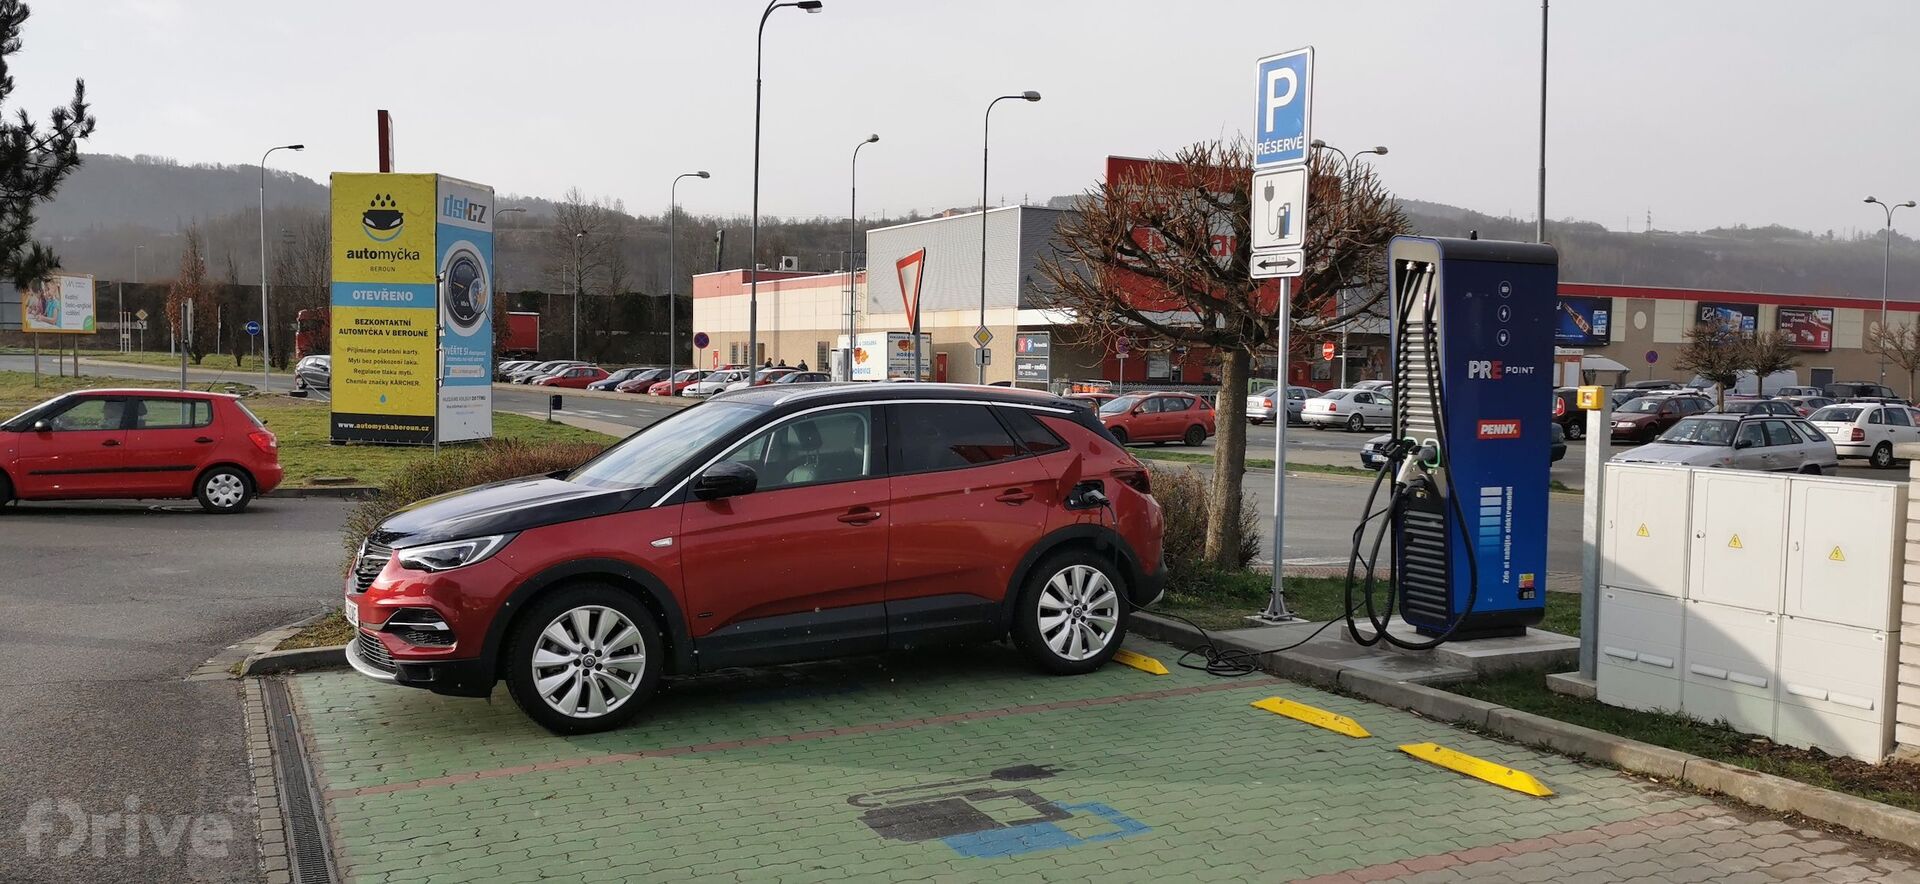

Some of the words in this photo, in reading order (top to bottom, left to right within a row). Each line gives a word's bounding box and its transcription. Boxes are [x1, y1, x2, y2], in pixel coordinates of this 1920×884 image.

[1266, 67, 1297, 132] P
[1257, 132, 1304, 154] RÉSERVÉ
[346, 247, 420, 262] automyčka
[352, 287, 414, 301] OTEVŘENO
[354, 318, 411, 327] BEZKONTAKTNÍ
[338, 327, 384, 336] AUTOMYČKA
[377, 347, 402, 355] platební
[373, 358, 403, 366] poškození
[353, 368, 381, 376] Regulace
[1468, 360, 1503, 379] PRE
[1505, 366, 1534, 374] POINT
[336, 421, 430, 432] www.automyckaberoun.cz
[1504, 486, 1513, 534] elektromobil
[1503, 561, 1511, 569] si
[1502, 570, 1510, 584] Zde
